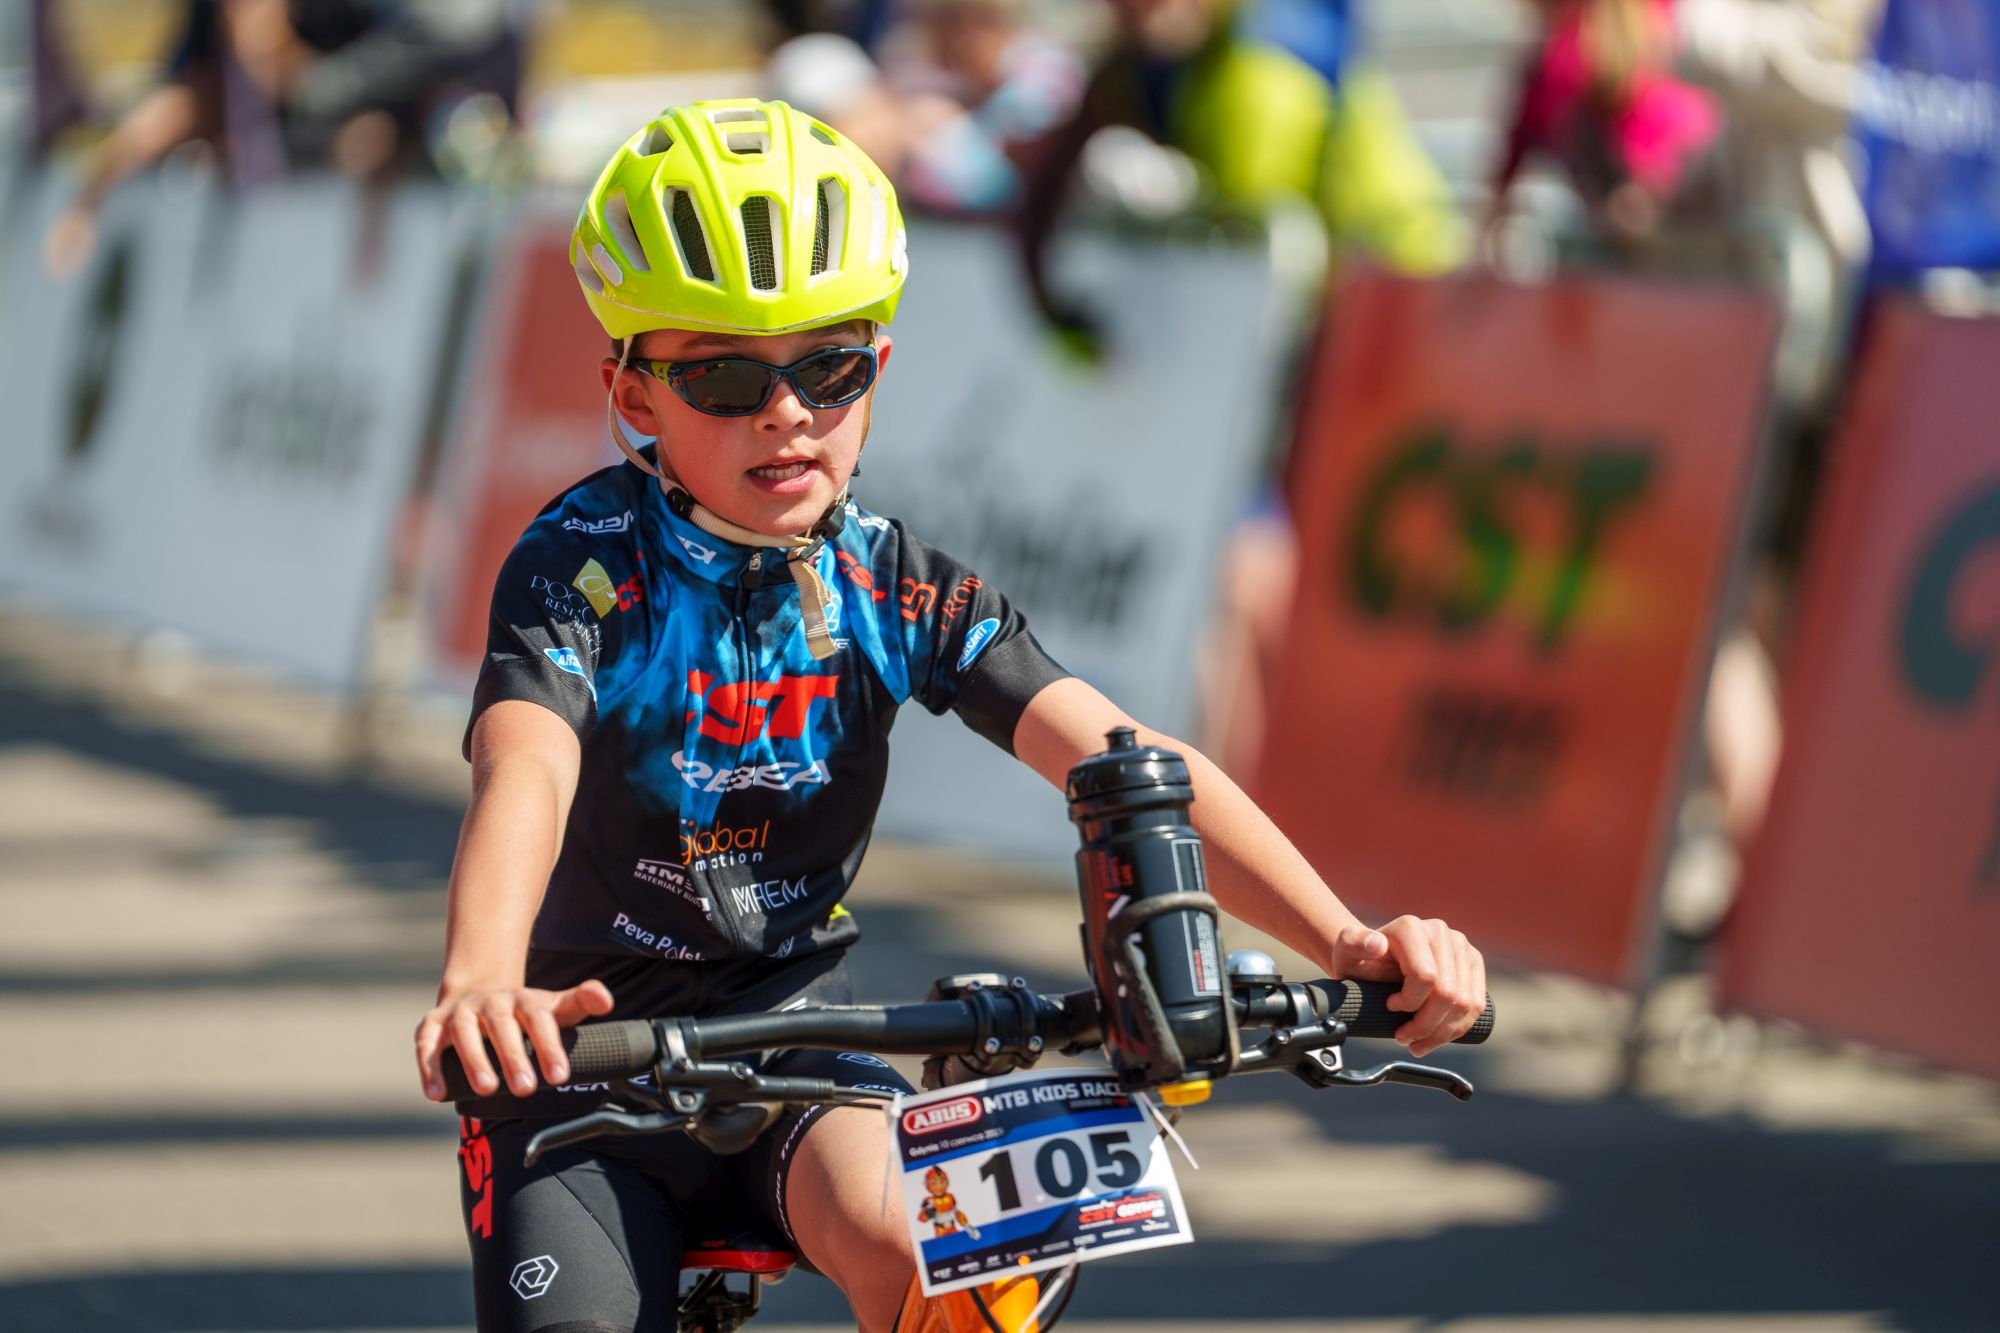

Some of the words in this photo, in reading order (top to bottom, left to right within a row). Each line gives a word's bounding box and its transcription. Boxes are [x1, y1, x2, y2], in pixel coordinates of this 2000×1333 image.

[1347, 425, 1658, 650] CST
[695, 851, 764, 872] motion
[613, 912, 656, 946] Peva
[912, 1101, 973, 1129] ABUS
[983, 1089, 1030, 1115] MTB
[1031, 1083, 1080, 1104] KIDS
[979, 1131, 1142, 1212] 105
